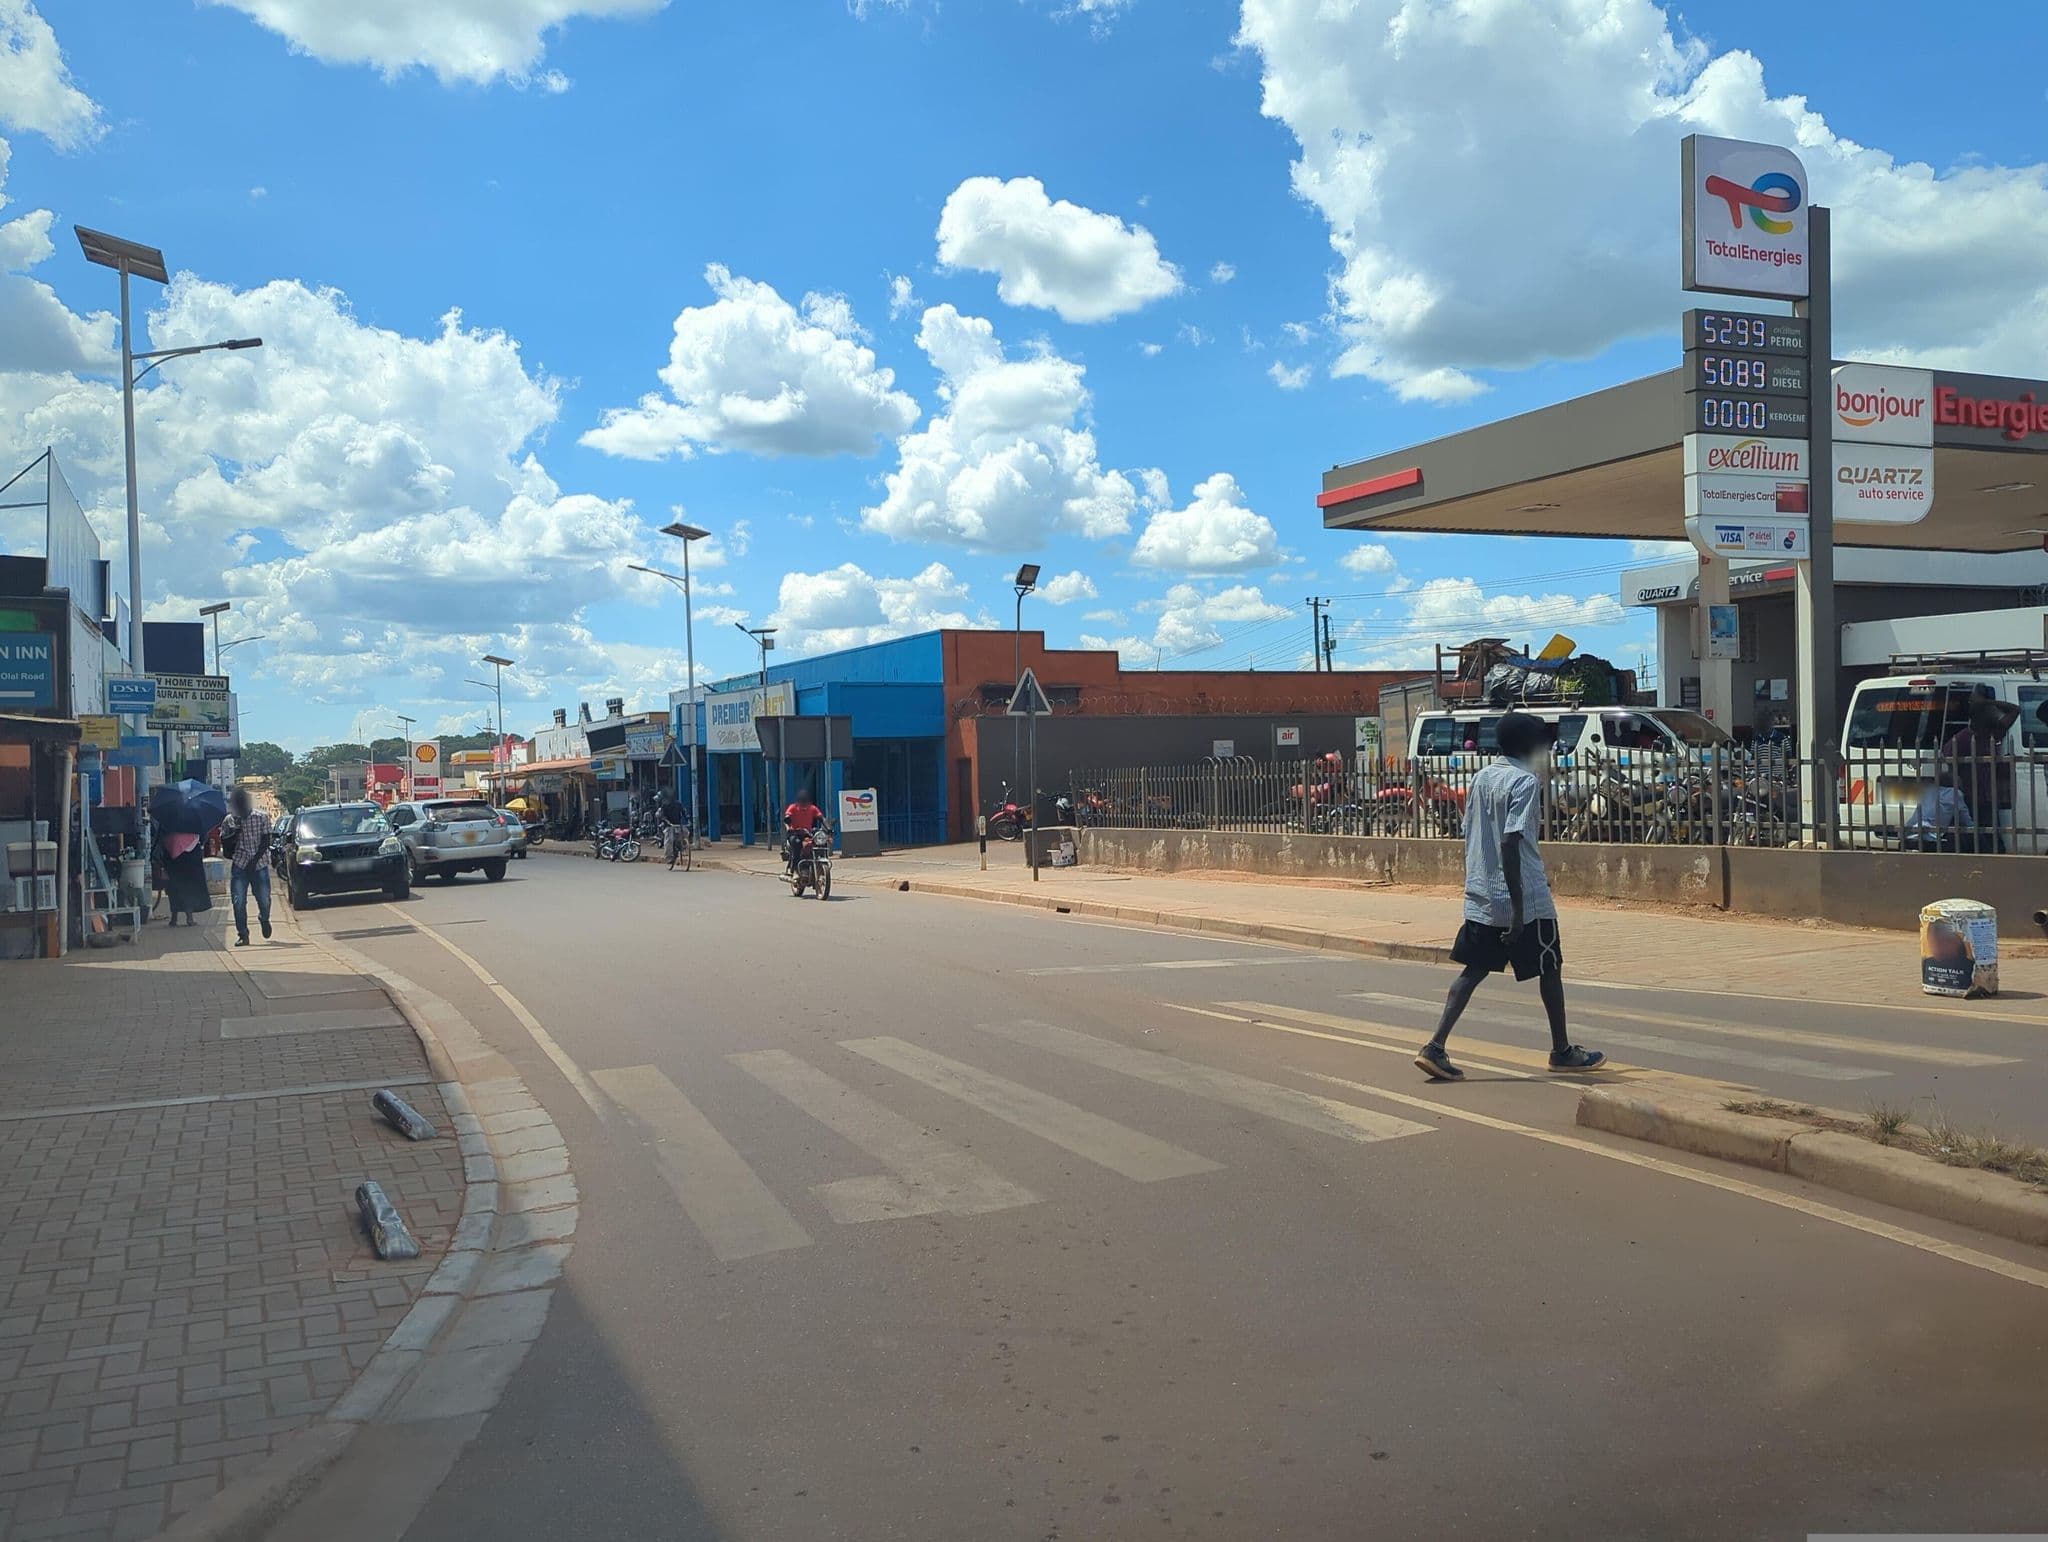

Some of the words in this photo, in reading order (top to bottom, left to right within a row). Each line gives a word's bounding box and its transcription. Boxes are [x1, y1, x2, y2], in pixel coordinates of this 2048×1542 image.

[1706, 240, 1802, 267] TotalEnergies
[1704, 316, 1765, 347] 5299
[1770, 336, 1804, 349] PETROL
[1704, 357, 1765, 388] 5089
[1772, 377, 1802, 389] DIESEL
[1836, 383, 1925, 422] bonjour
[1704, 399, 1765, 429] 0000
[1769, 412, 1806, 423] KEROSENE
[1708, 445, 1799, 471] excellium
[1837, 467, 1924, 485] QUARTZ
[1702, 489, 1755, 502] TotalEnergies
[1756, 492, 1775, 501] Card
[1858, 488, 1884, 500] auto
[1886, 489, 1924, 500] service
[1720, 532, 1742, 543] VISA
[1729, 571, 1762, 585] ervice
[1638, 586, 1679, 600] QUARTZ
[15, 646, 48, 659] INN
[20, 672, 45, 680] Road
[165, 678, 193, 687] HOME
[196, 680, 225, 688] TOWN
[200, 692, 227, 701] LODGE
[711, 701, 751, 726] PREMIER
[1281, 729, 1294, 740] air
